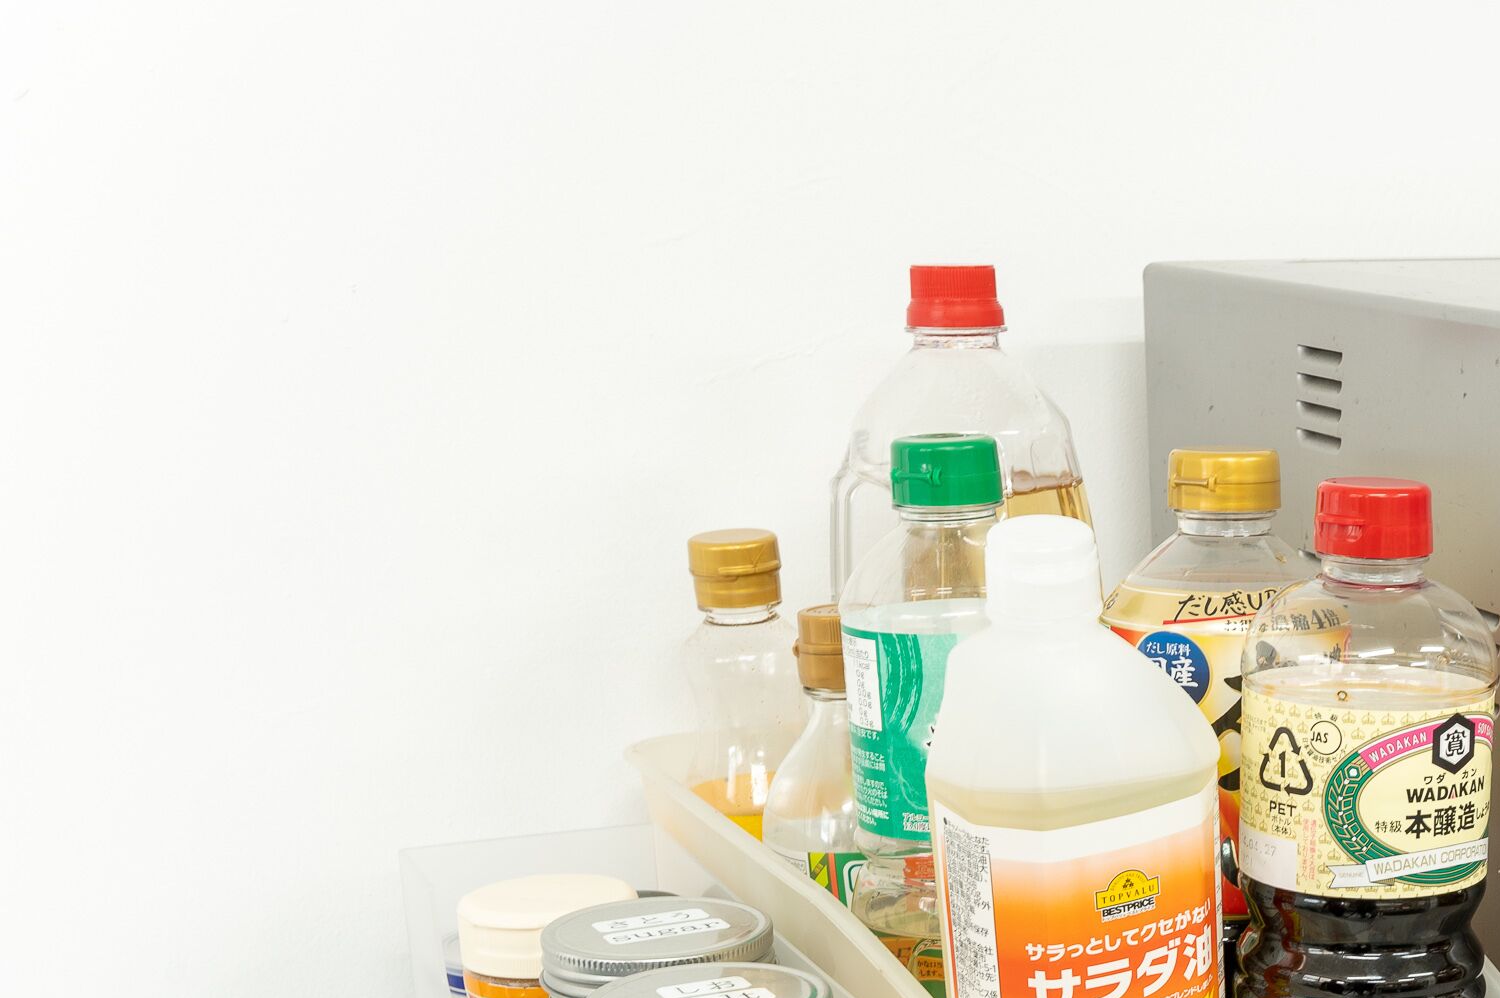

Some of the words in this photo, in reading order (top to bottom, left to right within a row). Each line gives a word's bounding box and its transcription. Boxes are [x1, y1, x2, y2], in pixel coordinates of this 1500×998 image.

[1146, 642, 1192, 657] だし原料
[1311, 731, 1329, 744] JAS
[1368, 732, 1428, 763] WADAKAN
[1278, 750, 1286, 778] 1
[1424, 772, 1446, 785] ワダ
[1462, 768, 1478, 779] カン
[1406, 776, 1485, 804] WADAKAN
[1270, 800, 1297, 817] PET
[1272, 815, 1291, 826] ボトル
[1375, 820, 1402, 834] 特級
[1405, 801, 1476, 839] 本醸造
[1373, 854, 1437, 876] WADAKAN
[1102, 884, 1155, 904] TOPVALU
[1102, 897, 1155, 917] BESTPRICE
[610, 912, 690, 930] さとう
[1025, 897, 1211, 962] サラっとしてクセがない
[612, 920, 719, 943] sugar
[676, 981, 735, 995] しお
